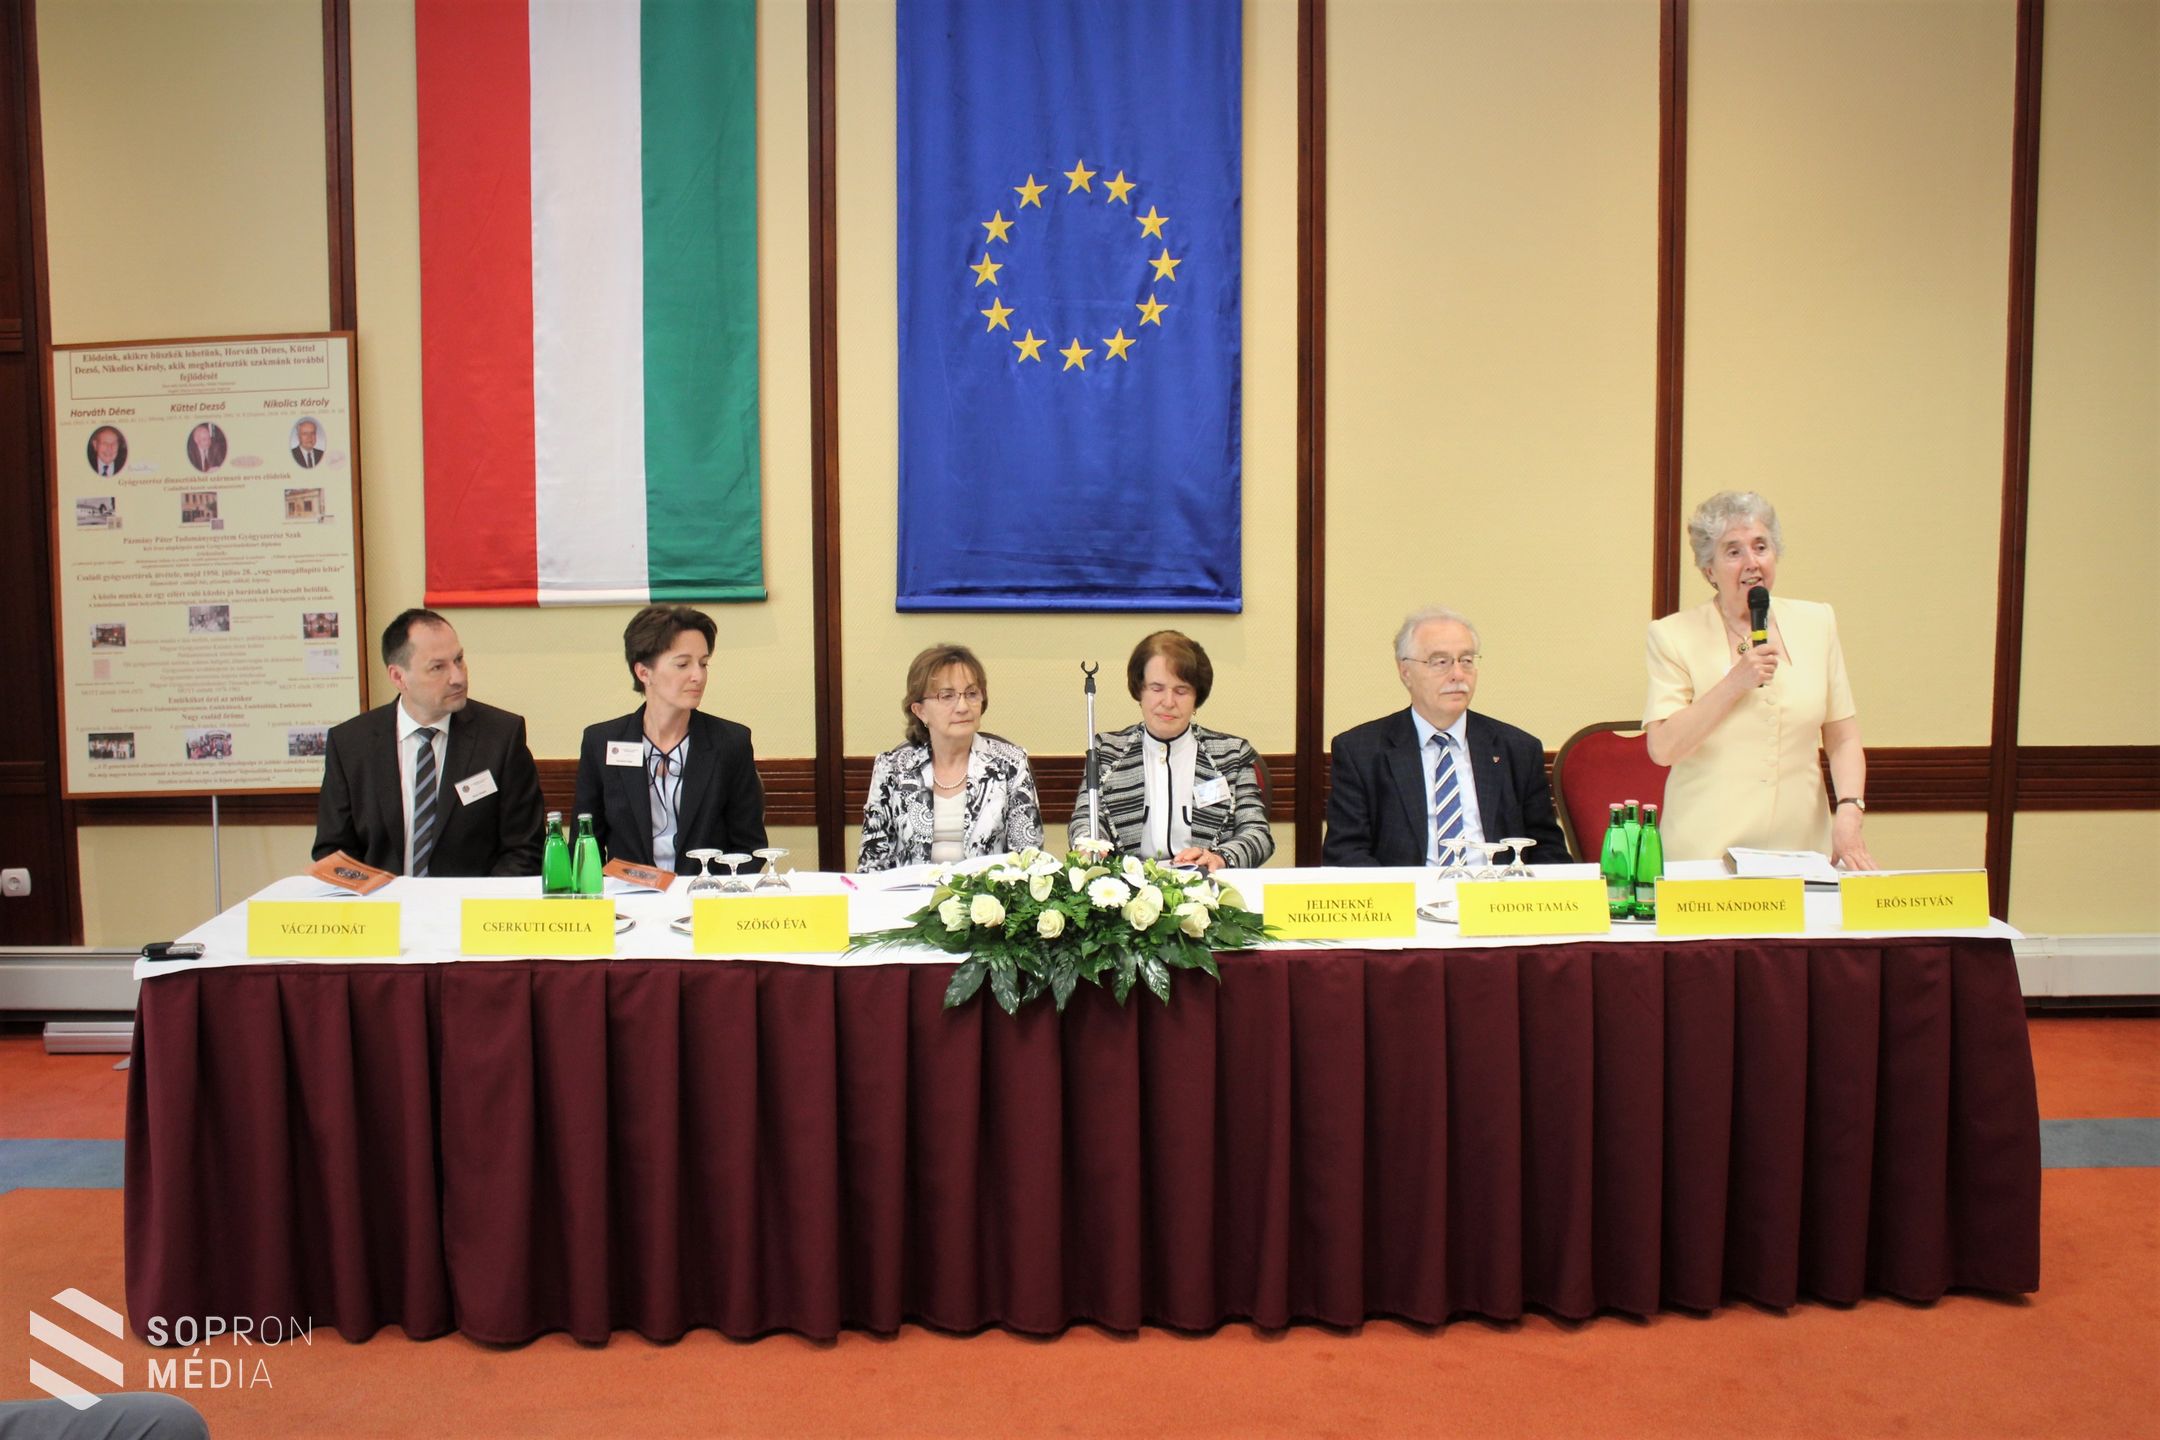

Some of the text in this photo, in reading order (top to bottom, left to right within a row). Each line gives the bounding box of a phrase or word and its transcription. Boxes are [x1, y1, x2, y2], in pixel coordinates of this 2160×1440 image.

[123, 352, 148, 361] akikre
[225, 347, 259, 356] Horváth
[261, 346, 287, 355] Dénes,
[290, 345, 315, 353] Küttel
[102, 364, 134, 373] Nikolics
[136, 363, 166, 373] Károly,
[168, 362, 186, 370] akik
[250, 357, 291, 366] szakmánk
[293, 355, 324, 364] további
[170, 401, 226, 412] Küttel Dezső
[263, 397, 330, 409] Nikolics Károly
[70, 407, 136, 418] Horváth Dénes
[1307, 898, 1374, 911] JELINEKNÉ
[1489, 900, 1579, 913] FODOR TAMÁS
[1716, 899, 1786, 912] NÁNDORNÉ
[1910, 894, 1953, 907] ISTVÁN
[783, 917, 807, 929] ÉVA
[1288, 910, 1392, 923] NIKOLICS MÁRIA
[281, 922, 366, 934] VÁCZI DONÁT
[483, 921, 592, 932] CSERKUTI CSILLA
